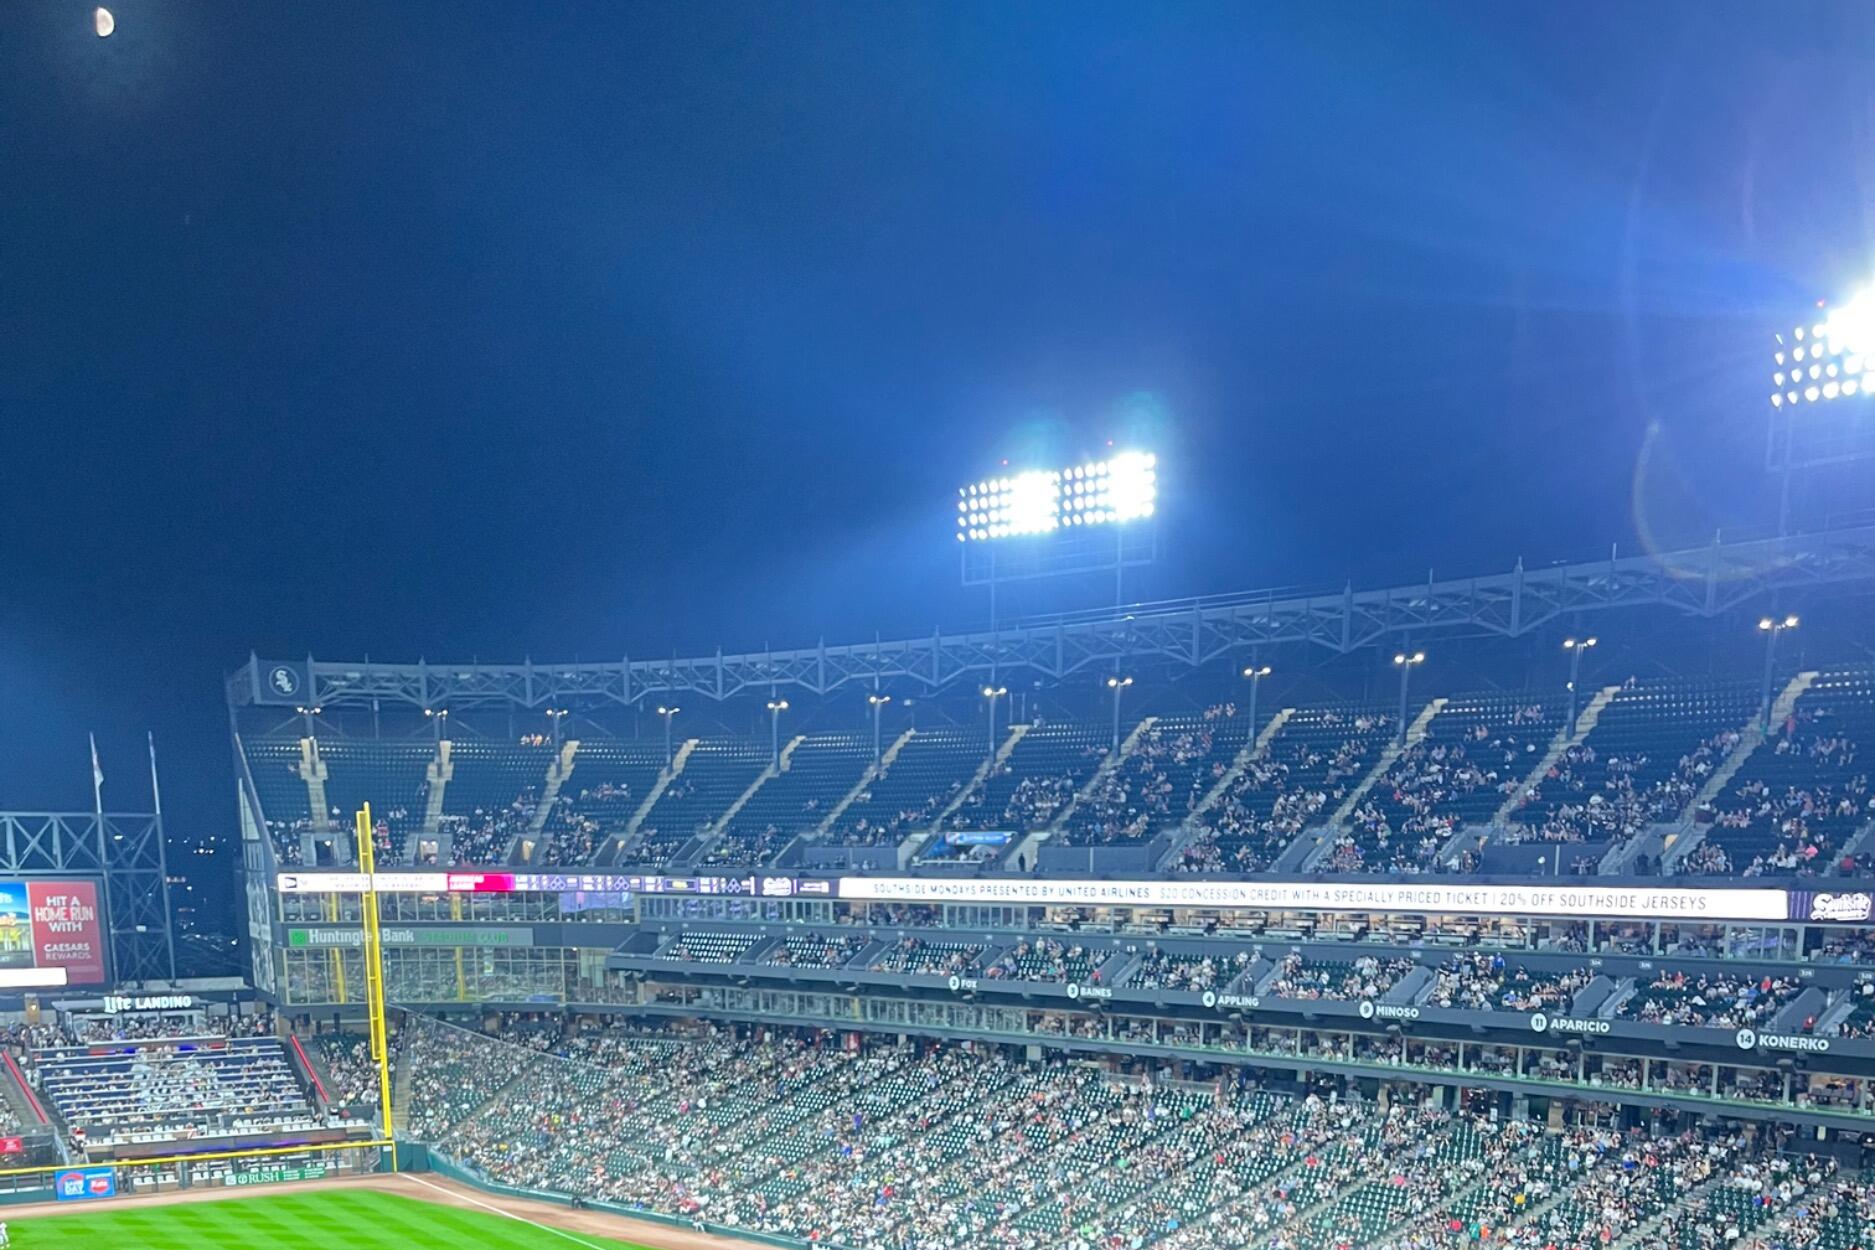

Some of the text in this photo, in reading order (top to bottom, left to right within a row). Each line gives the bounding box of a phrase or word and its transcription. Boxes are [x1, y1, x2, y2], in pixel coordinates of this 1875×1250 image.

[46, 896, 80, 906] HIT A
[873, 883, 926, 895] SOUTHSIDE
[930, 884, 977, 896] MONDAYS
[979, 885, 1038, 897] PRESENTED
[1041, 885, 1054, 897] BY
[1058, 886, 1097, 898] UNITED
[1101, 887, 1150, 899] AIRLINES
[1181, 888, 1246, 901] CONCESSION
[1249, 889, 1287, 901] CREDIT
[1292, 889, 1319, 902] WITH
[1323, 890, 1331, 902] A
[1334, 890, 1393, 903] SPECIALLY
[1398, 891, 1441, 904] PRICED
[1446, 891, 1488, 905] TICKET
[1499, 892, 1527, 906] 20%
[1531, 893, 1554, 907] OFF
[1559, 893, 1637, 909] SOUTHSIDE
[1641, 895, 1707, 910] JERSEYS
[35, 907, 94, 921] HOME RUN
[49, 922, 82, 932] WITH
[382, 928, 414, 943] Bank
[44, 943, 90, 952] CAESARS
[1080, 987, 1112, 998] BAINES
[135, 996, 192, 1009] LANDING
[1217, 995, 1260, 1007] APPLING
[1550, 1019, 1610, 1033] APARICIO
[1759, 1034, 1830, 1051] KONERKO
